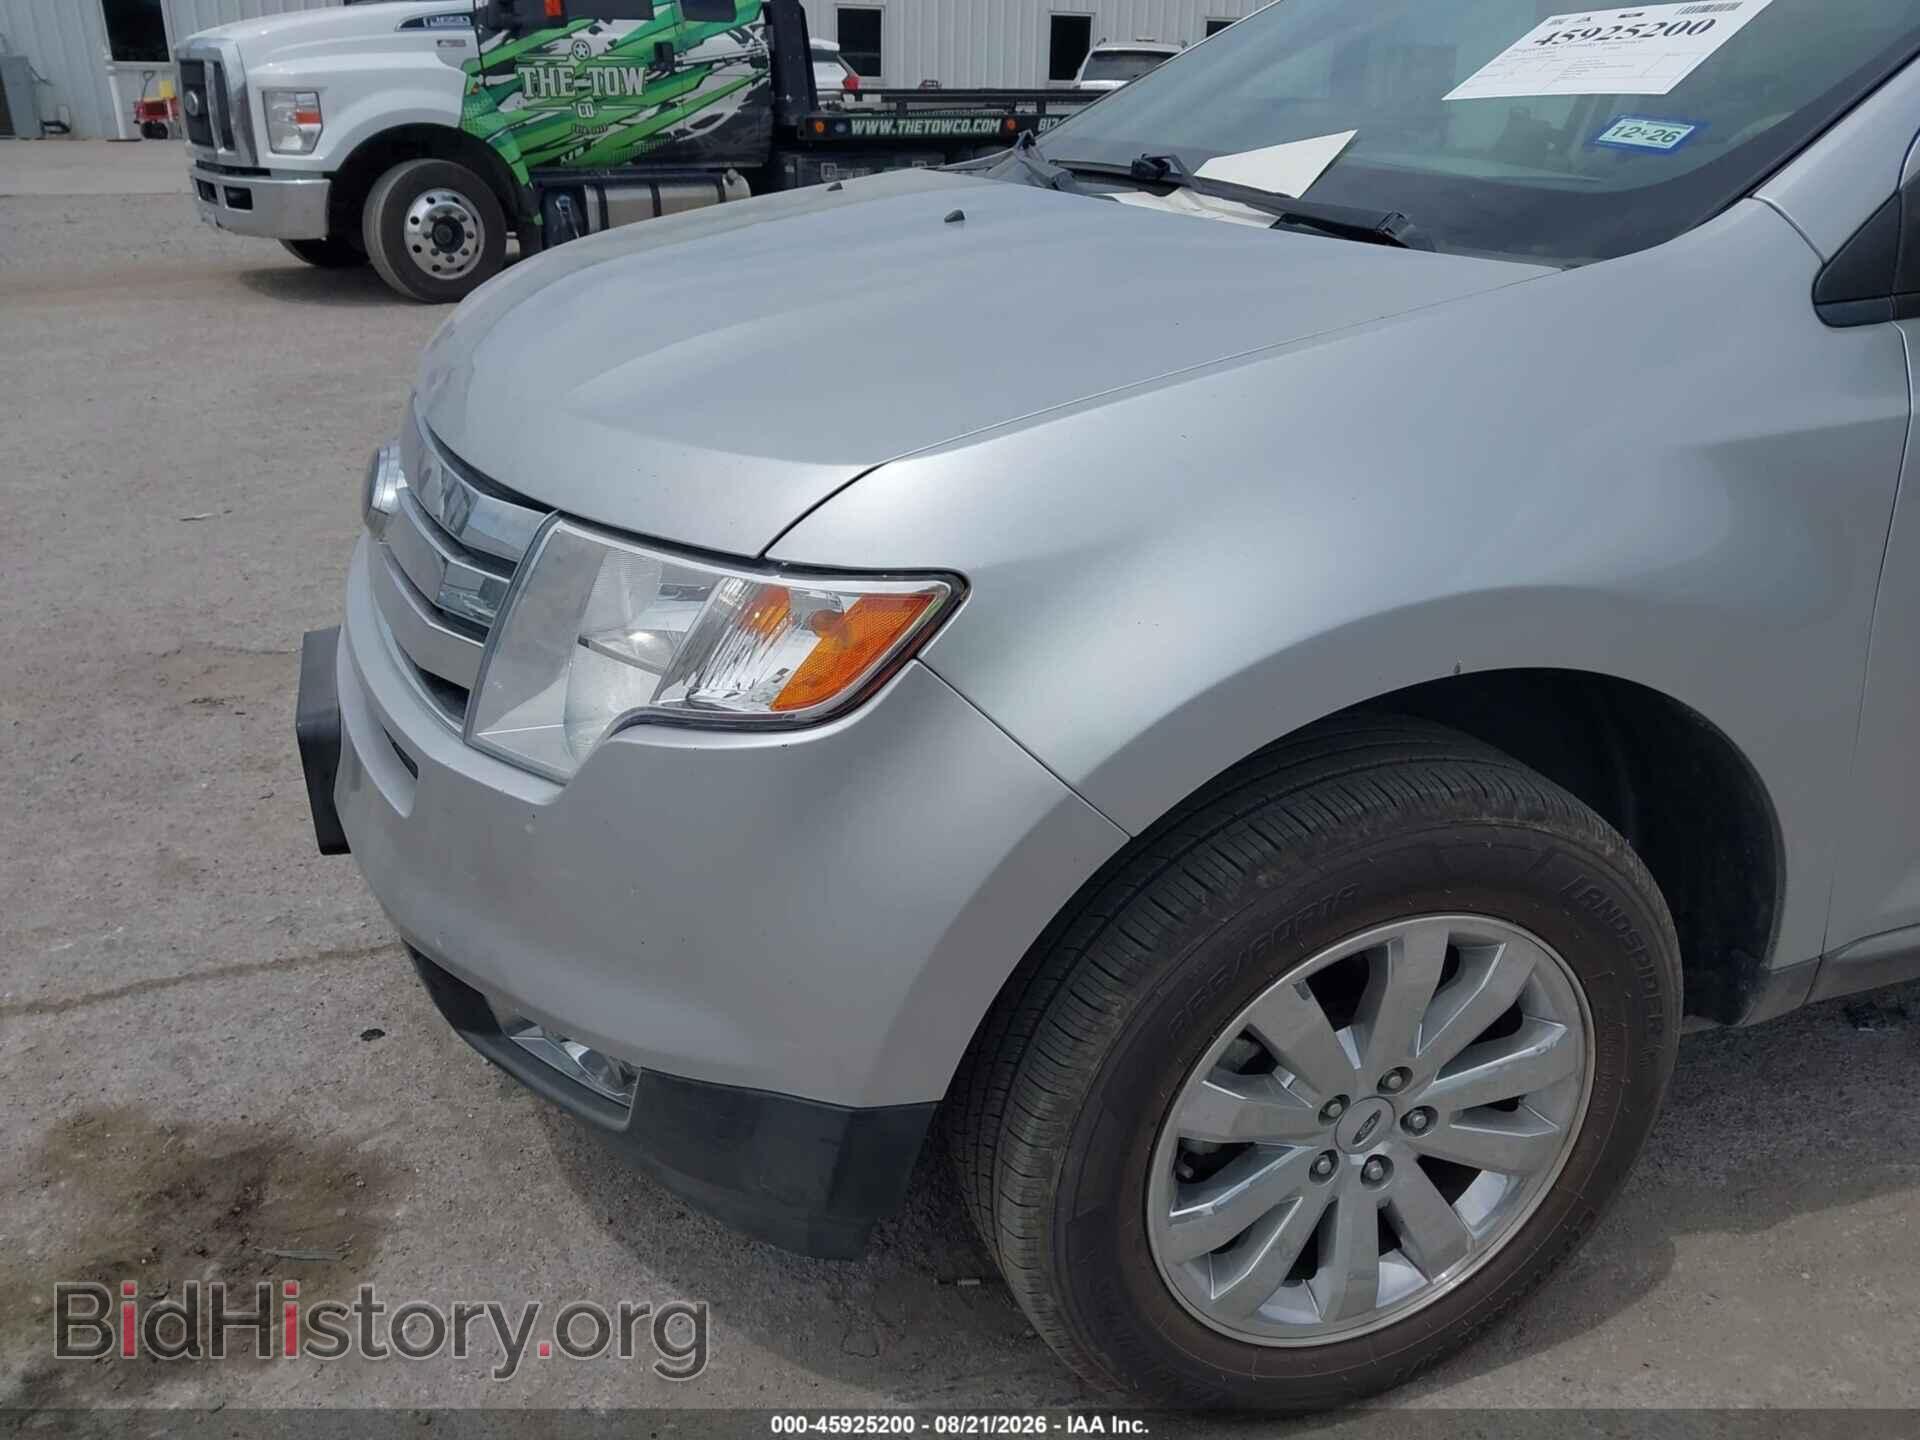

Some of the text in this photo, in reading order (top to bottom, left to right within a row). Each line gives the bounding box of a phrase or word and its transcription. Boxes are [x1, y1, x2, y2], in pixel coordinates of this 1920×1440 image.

[1534, 18, 1716, 46] 45925200
[517, 66, 647, 98] THE TOW
[577, 102, 594, 118] CO
[850, 117, 1002, 136] WWW.THETOWCO.COM
